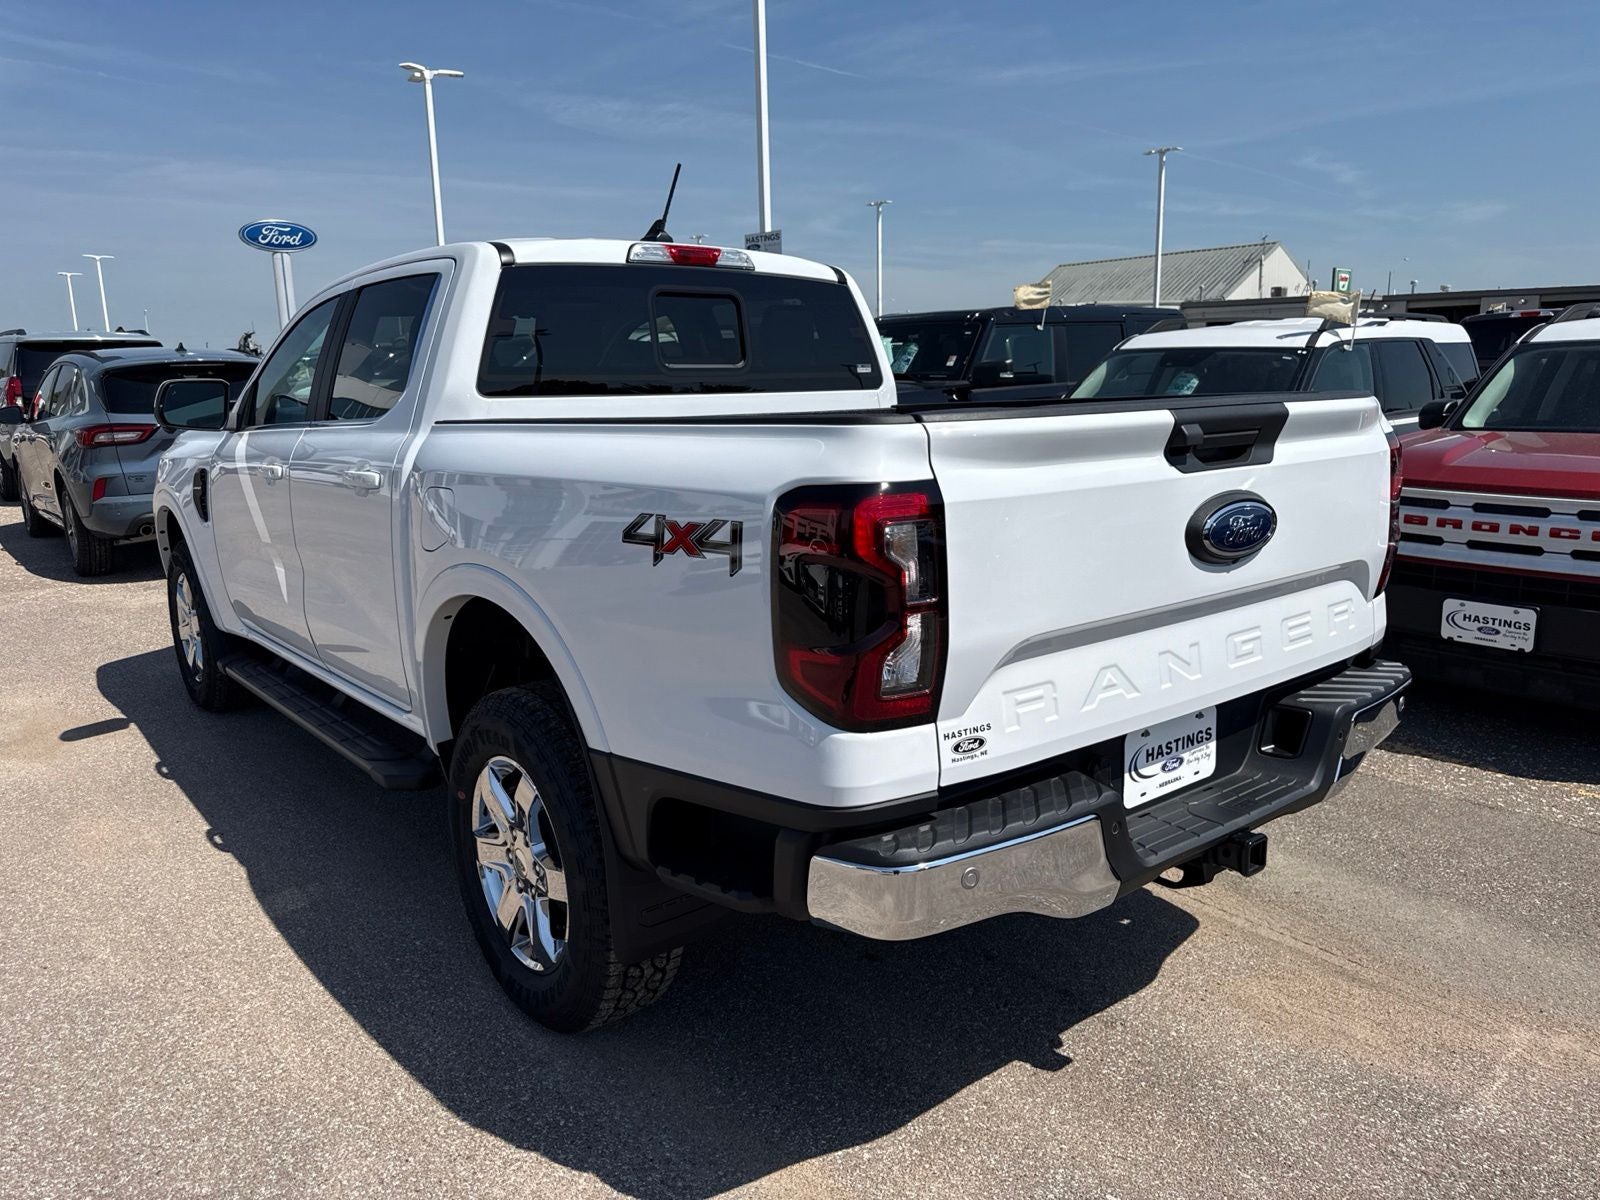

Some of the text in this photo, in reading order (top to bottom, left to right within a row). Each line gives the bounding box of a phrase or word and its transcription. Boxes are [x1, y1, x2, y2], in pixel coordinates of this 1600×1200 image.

[258, 225, 303, 245] Ford
[745, 233, 780, 244] HASTINGS
[1223, 513, 1264, 546] Ford
[1403, 513, 1600, 542] BRONC
[1462, 613, 1531, 631] HASTINGS
[1002, 597, 1356, 733] RANGER
[943, 722, 992, 741] HASTINGS
[958, 739, 980, 752] Ford
[1145, 726, 1213, 764] HASTINGS
[1158, 775, 1182, 788] NEBRASKA
